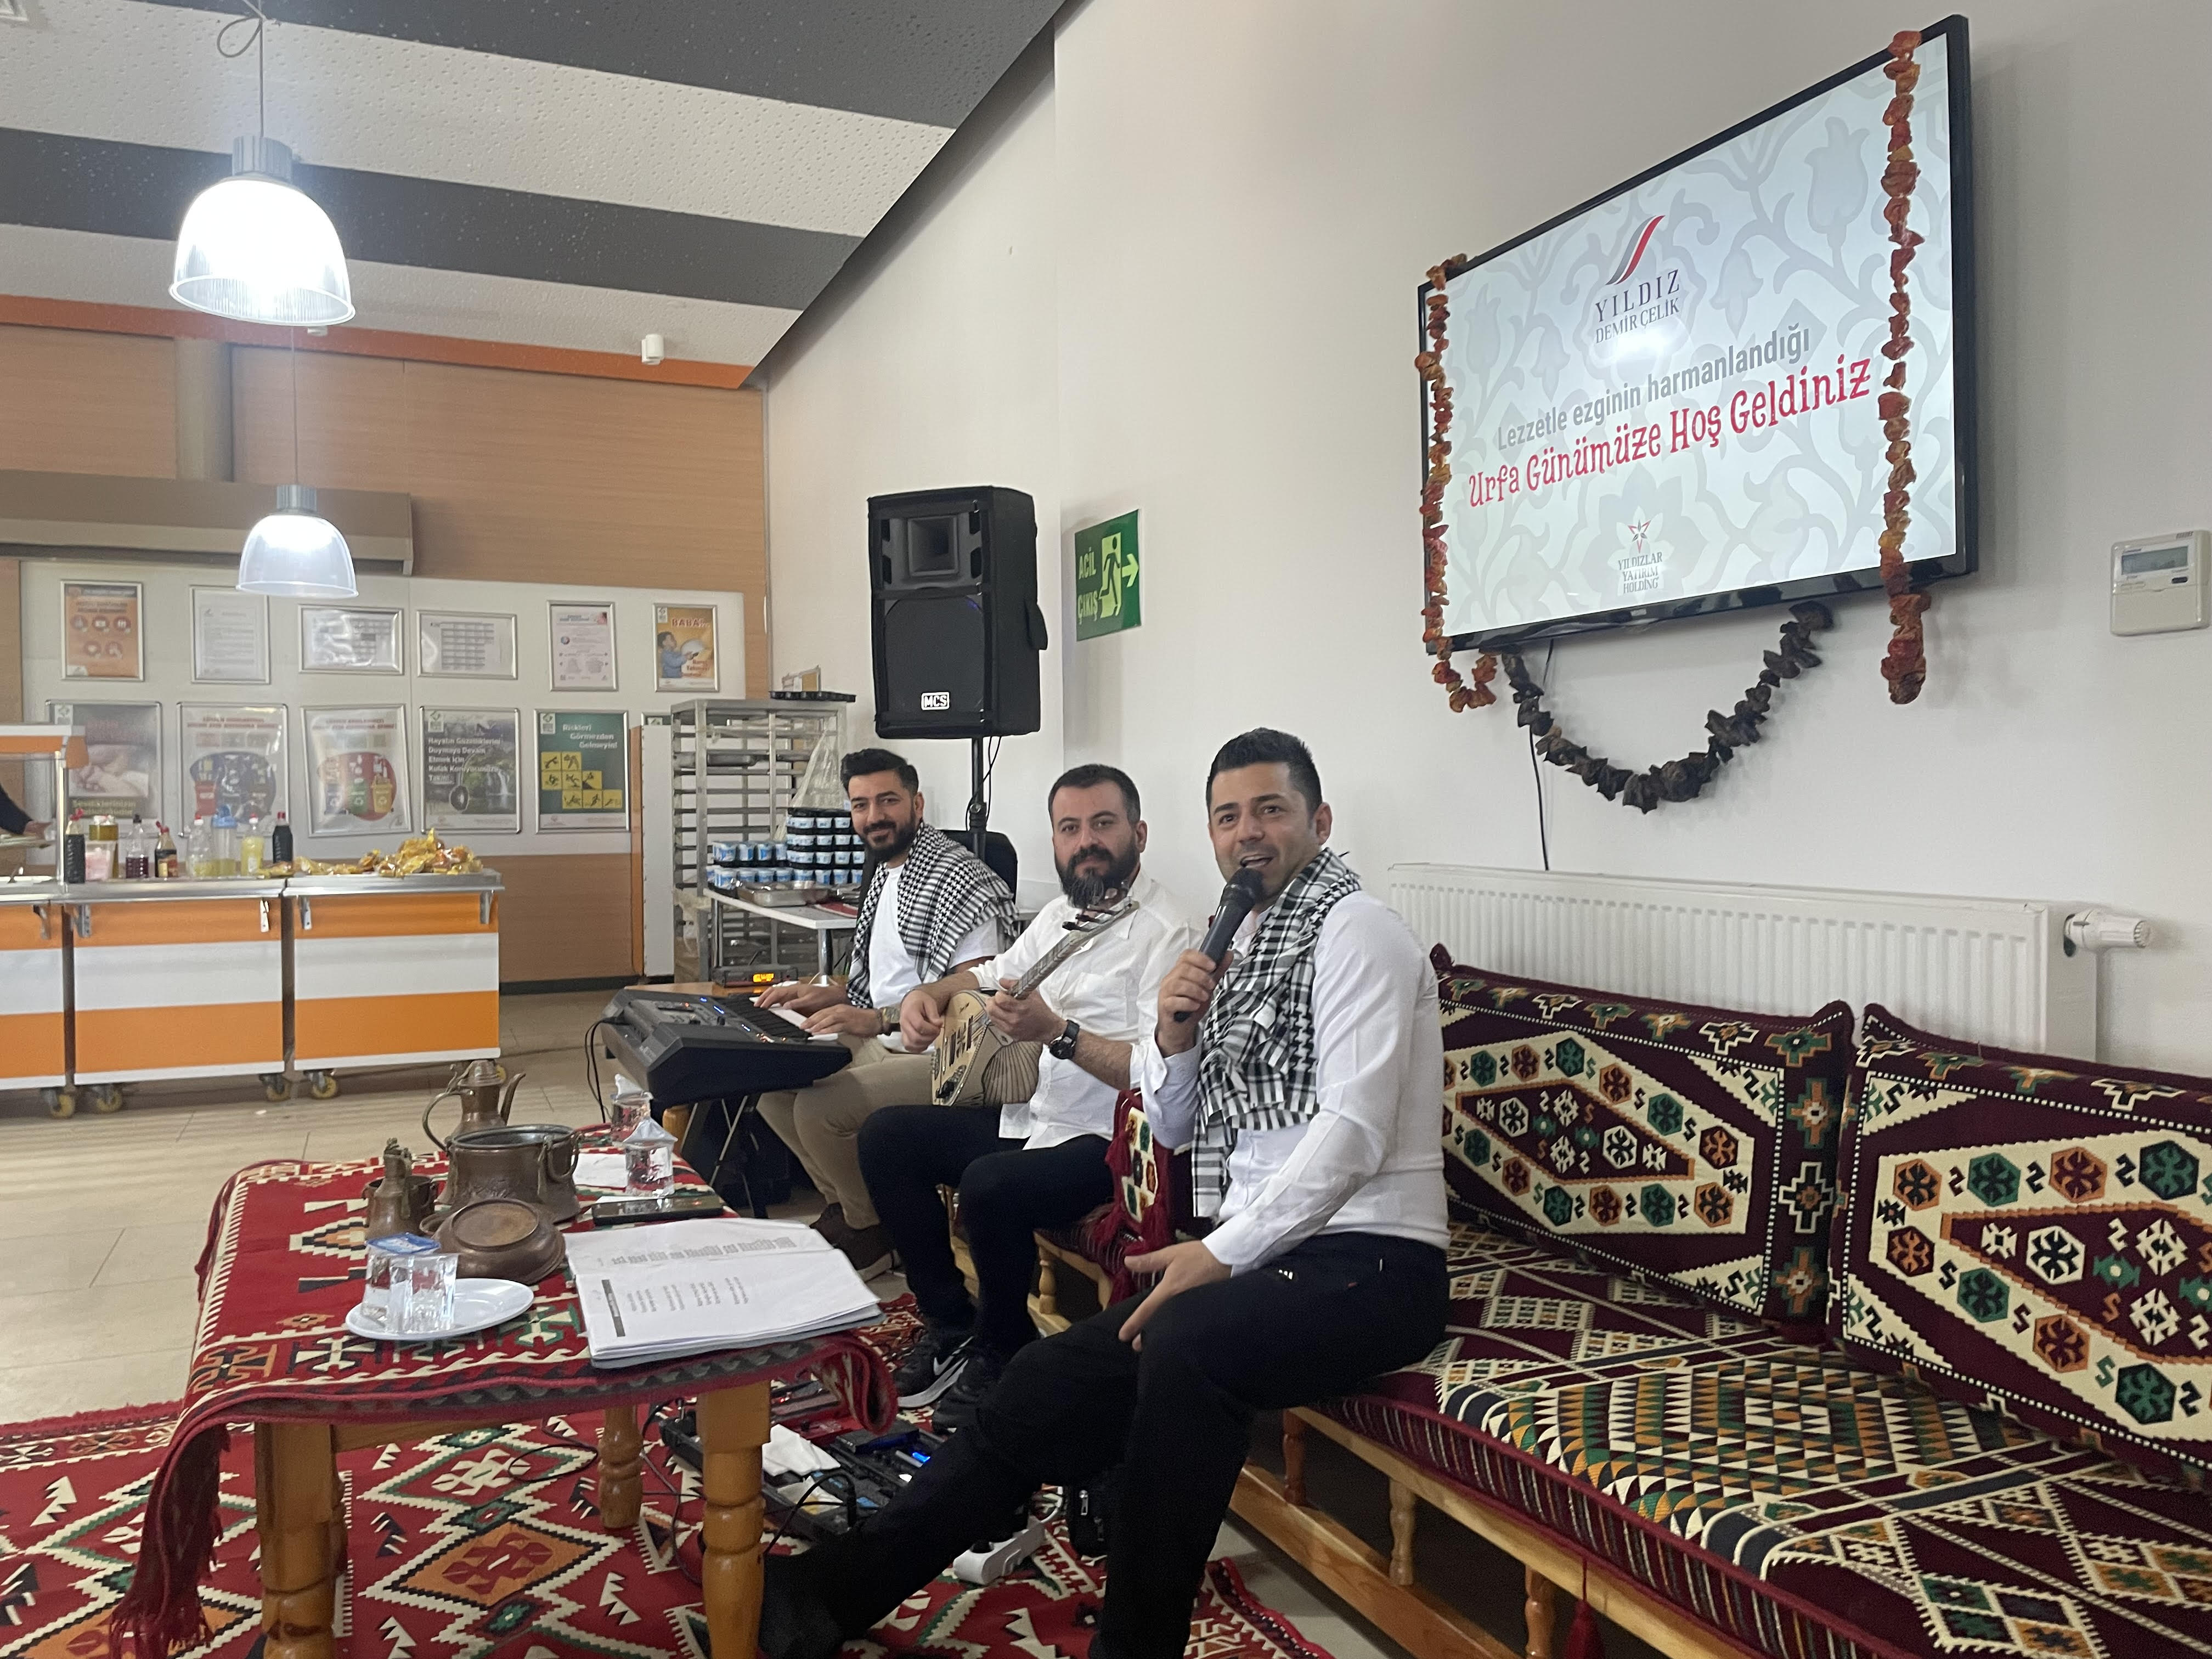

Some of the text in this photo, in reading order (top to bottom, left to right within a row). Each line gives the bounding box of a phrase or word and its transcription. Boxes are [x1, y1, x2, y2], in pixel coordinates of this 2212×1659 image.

[1595, 269, 1679, 323] YILDIZ
[1596, 297, 1679, 343] DEMİR ÇELİK
[1498, 322, 1809, 450] Lezzetle ezginin harmanlandığı
[1469, 354, 1871, 507] Urfa Günümüze Hoş Geldiniz
[1079, 546, 1096, 580] ACİL
[1618, 551, 1662, 571] YILDIZLAR
[1622, 566, 1659, 582] YATIRIM
[1077, 590, 1098, 625] ÇIKIŞ
[924, 695, 947, 708] MCS
